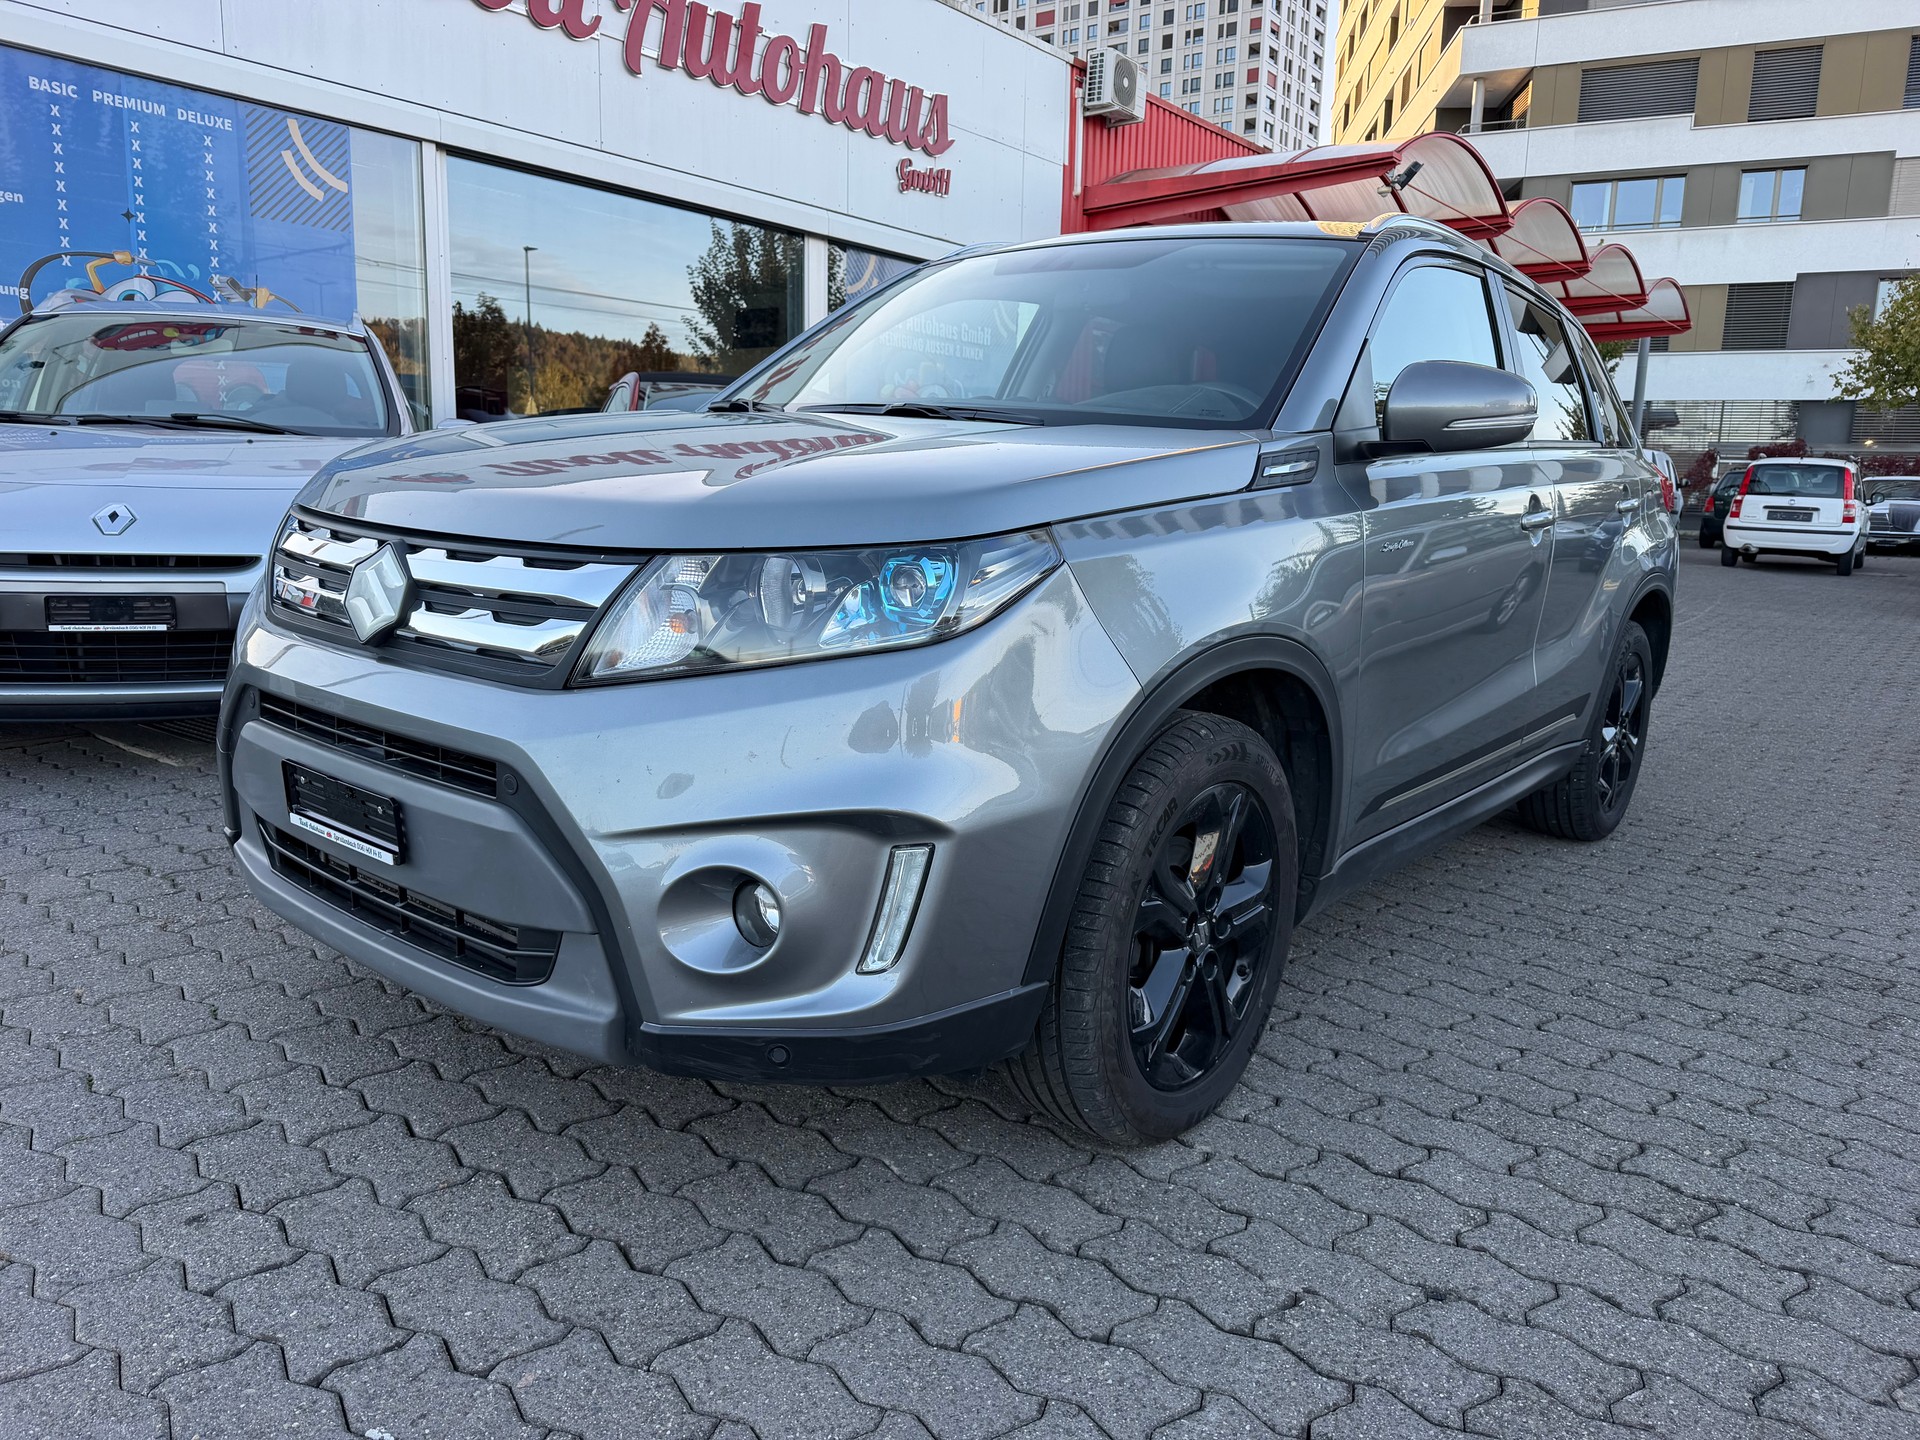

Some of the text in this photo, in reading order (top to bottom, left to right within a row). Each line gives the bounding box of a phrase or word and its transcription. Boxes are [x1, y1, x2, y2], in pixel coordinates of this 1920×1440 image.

[611, 0, 955, 157] Autohaus
[28, 75, 233, 132] BASIC PREMIUM DELUXE
[896, 156, 952, 197] GmbH
[961, 322, 992, 346] GmbH
